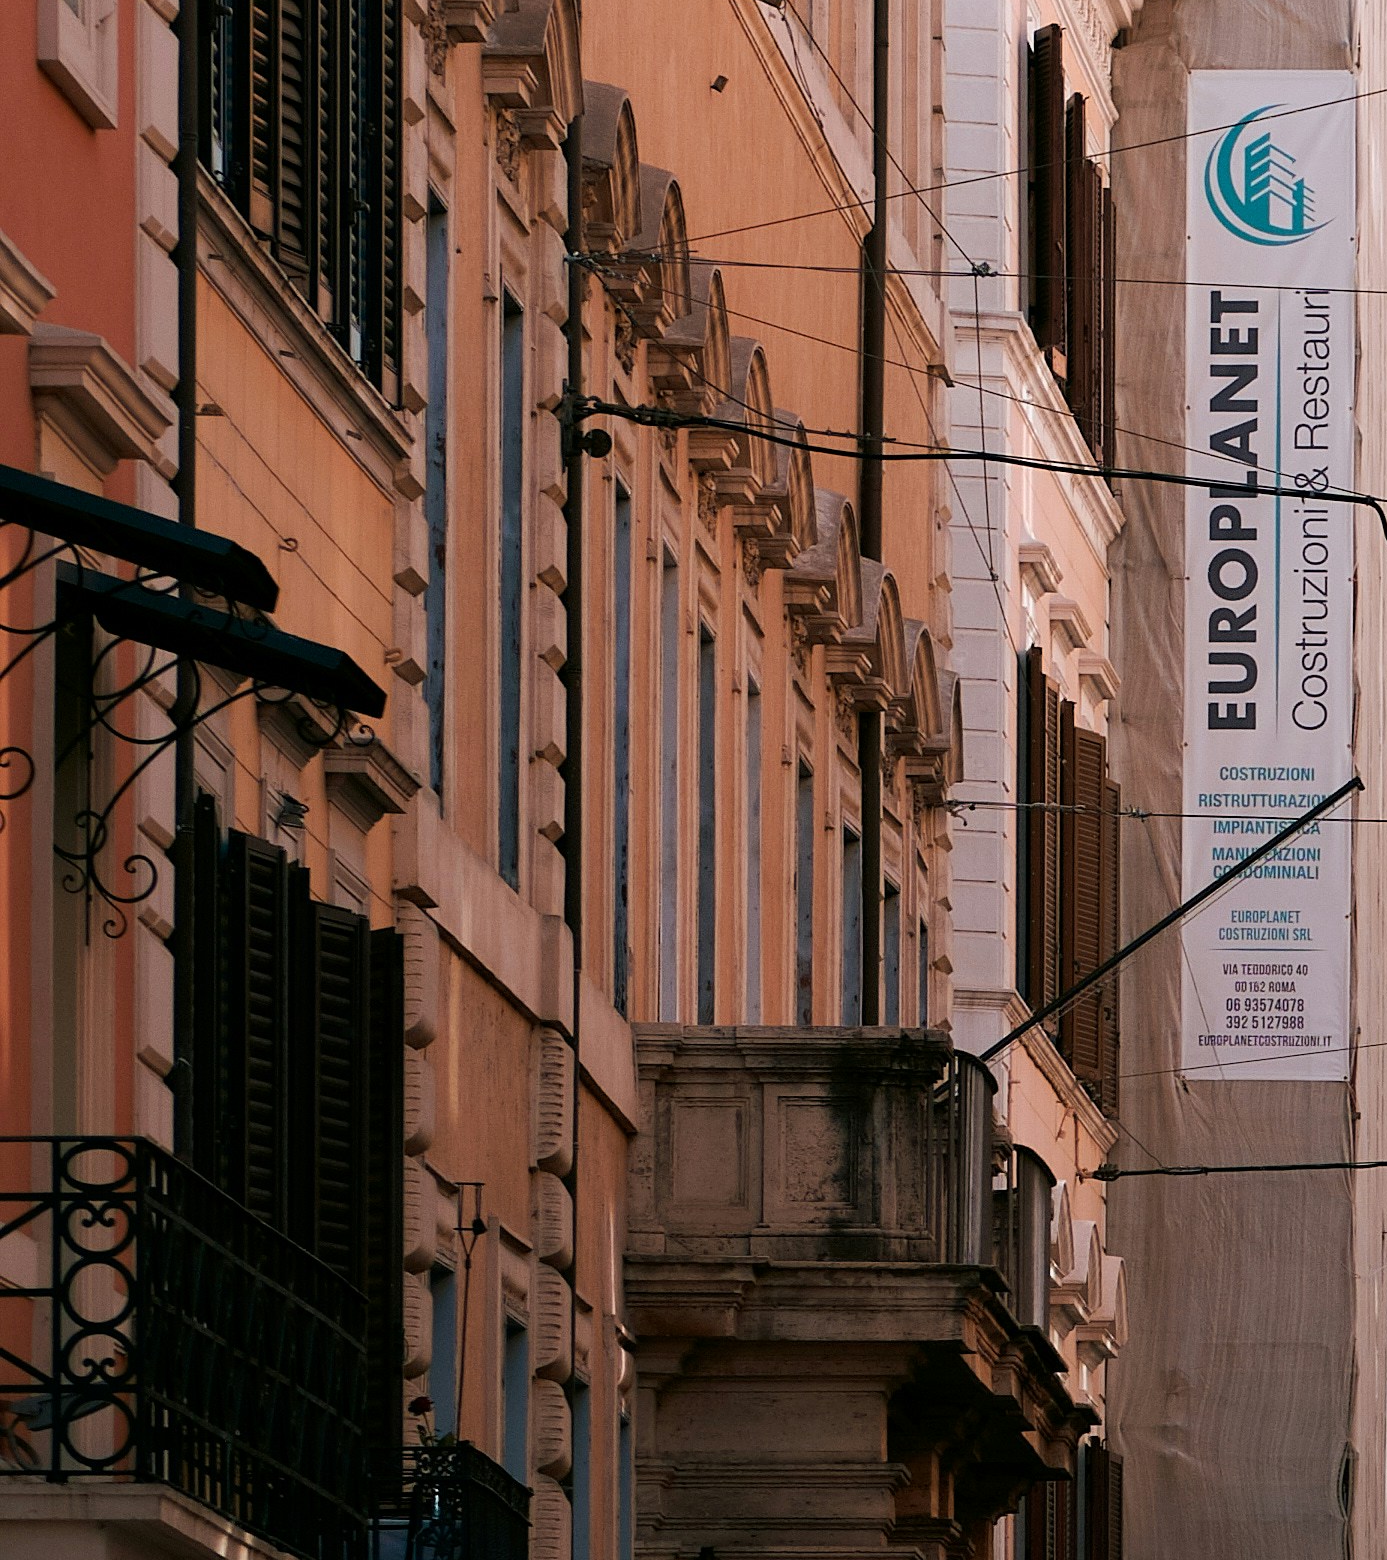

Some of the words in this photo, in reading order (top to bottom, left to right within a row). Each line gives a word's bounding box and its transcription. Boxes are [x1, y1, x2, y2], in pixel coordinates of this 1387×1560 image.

[1294, 289, 1331, 450] Restauri
[1294, 466, 1329, 493] &
[1207, 290, 1259, 730] EUROPLANET
[1292, 508, 1329, 731] Costruzioni
[1219, 766, 1315, 781] COSTRUZIONI
[1198, 793, 1336, 809] RISTRUTTURAZIO
[1213, 865, 1319, 880] CODOMINIALI
[1231, 910, 1301, 923] EUROPLANET
[1218, 927, 1289, 941] COSTRUZIONI
[1293, 928, 1313, 941] SRL
[1222, 963, 1238, 976] VIA
[1242, 963, 1293, 976] TEODORICO
[1296, 964, 1309, 976] 40
[1269, 981, 1296, 993] ROMA
[1226, 998, 1241, 1012] 06
[1244, 998, 1305, 1012] 93574078
[1226, 1015, 1248, 1029] 392
[1252, 1015, 1305, 1029] 5127988
[1198, 1034, 1332, 1047] EUROPLANETCOSTRUZIONI.IT
